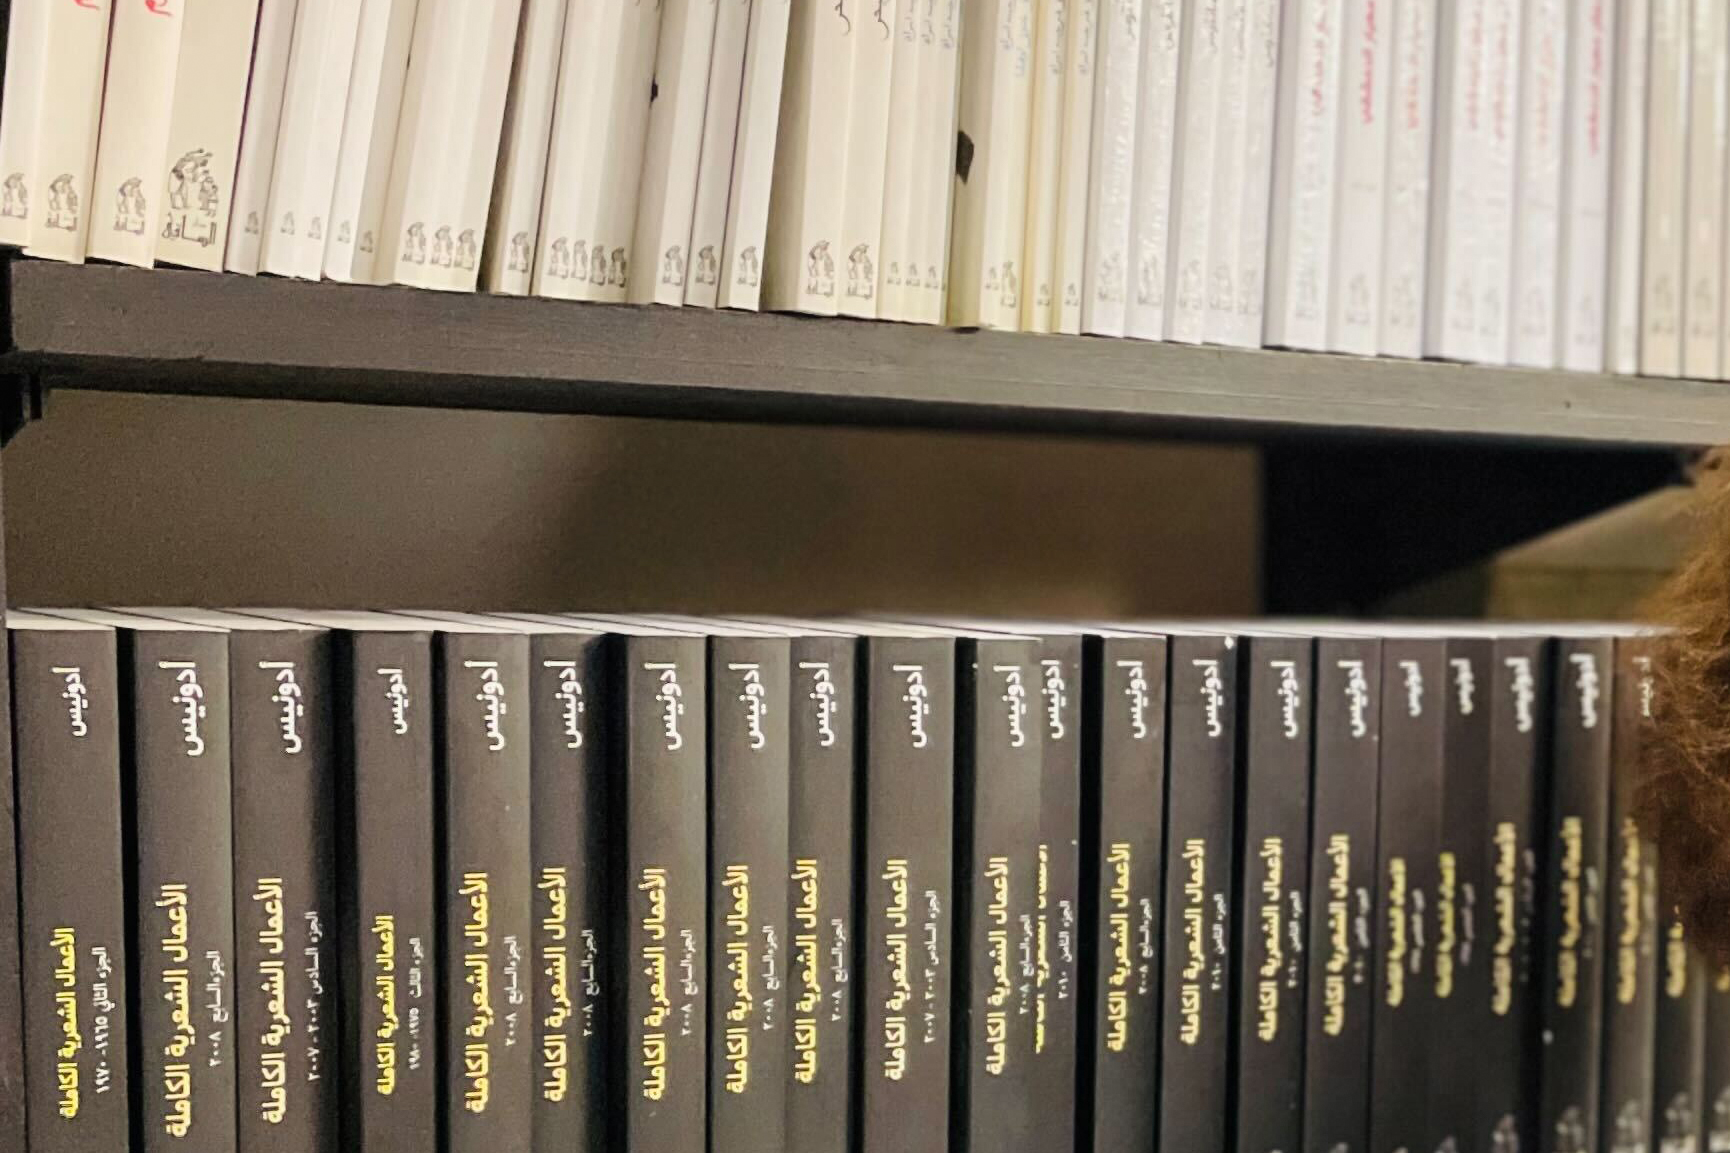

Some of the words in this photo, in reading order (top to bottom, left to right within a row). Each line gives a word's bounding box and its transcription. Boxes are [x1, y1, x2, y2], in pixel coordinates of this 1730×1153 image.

[52, 668, 88, 736] أدونيس
[159, 662, 206, 755] أدونيس
[259, 662, 303, 753] أدونيس
[377, 669, 408, 734] أدونيس
[464, 661, 506, 750] أدونيس
[544, 661, 583, 748] أدونيس
[645, 663, 684, 750] أدونيس
[729, 664, 767, 749] أدونيس
[799, 662, 837, 746] أدونيس
[893, 665, 929, 747] أدونيس
[994, 666, 1026, 747] أدونيس
[1041, 660, 1066, 738] أدونيس
[1117, 661, 1148, 738] أدونيس
[1192, 659, 1223, 737] أدونيس
[1271, 661, 1300, 737] أدونيس
[1338, 660, 1368, 737] أدونيس
[722, 865, 749, 935] الأعمال
[792, 860, 818, 928] الأعمال
[883, 860, 907, 927] الأعمال
[984, 857, 1008, 924] الأعمال
[1108, 844, 1130, 907] الأعمال
[1182, 839, 1204, 902] الأعمال
[1260, 838, 1282, 901] الأعمال
[1326, 835, 1349, 898] الأعمال
[156, 884, 188, 962] الأعمال
[253, 878, 283, 953] الأعمال
[459, 873, 488, 946] الأعمال
[539, 868, 566, 939] الأعمال
[638, 869, 666, 940] الأعمال
[1328, 902, 1348, 972] الشعرية
[50, 928, 75, 986] الأعمال
[372, 916, 394, 971] الأعمال
[796, 935, 818, 1012] الشعرية
[886, 934, 909, 1010] الشعرية
[988, 931, 1009, 1006] الشعرية
[1109, 914, 1131, 985] الشعرية
[1183, 908, 1204, 979] الشعرية
[1261, 905, 1281, 976] الشعرية
[163, 969, 191, 1056] الشعرية
[260, 961, 287, 1045] الشعرية
[376, 976, 398, 1038] الشعرية
[465, 954, 490, 1037] الشعرية
[544, 947, 568, 1027] الشعرية
[644, 947, 668, 1026] الشعرية
[727, 942, 750, 1021] الشعرية
[1181, 985, 1200, 1044] الكاملة
[1259, 981, 1277, 1040] الكاملة
[1325, 976, 1344, 1034] الكاملة
[56, 992, 80, 1058] الشعرية
[795, 1019, 816, 1083] الكاملة
[886, 1017, 906, 1080] الكاملة
[986, 1012, 1005, 1074] الكاملة
[1108, 991, 1126, 1051] الكاملة
[58, 1063, 78, 1118] الكاملة
[261, 1053, 286, 1123] الكاملة
[377, 1043, 395, 1094] الكاملة
[465, 1044, 489, 1113] الكاملة
[544, 1035, 567, 1101] الكاملة
[644, 1034, 666, 1100] الكاملة
[727, 1028, 748, 1093] الكاملة
[165, 1064, 190, 1137] الكاملة
